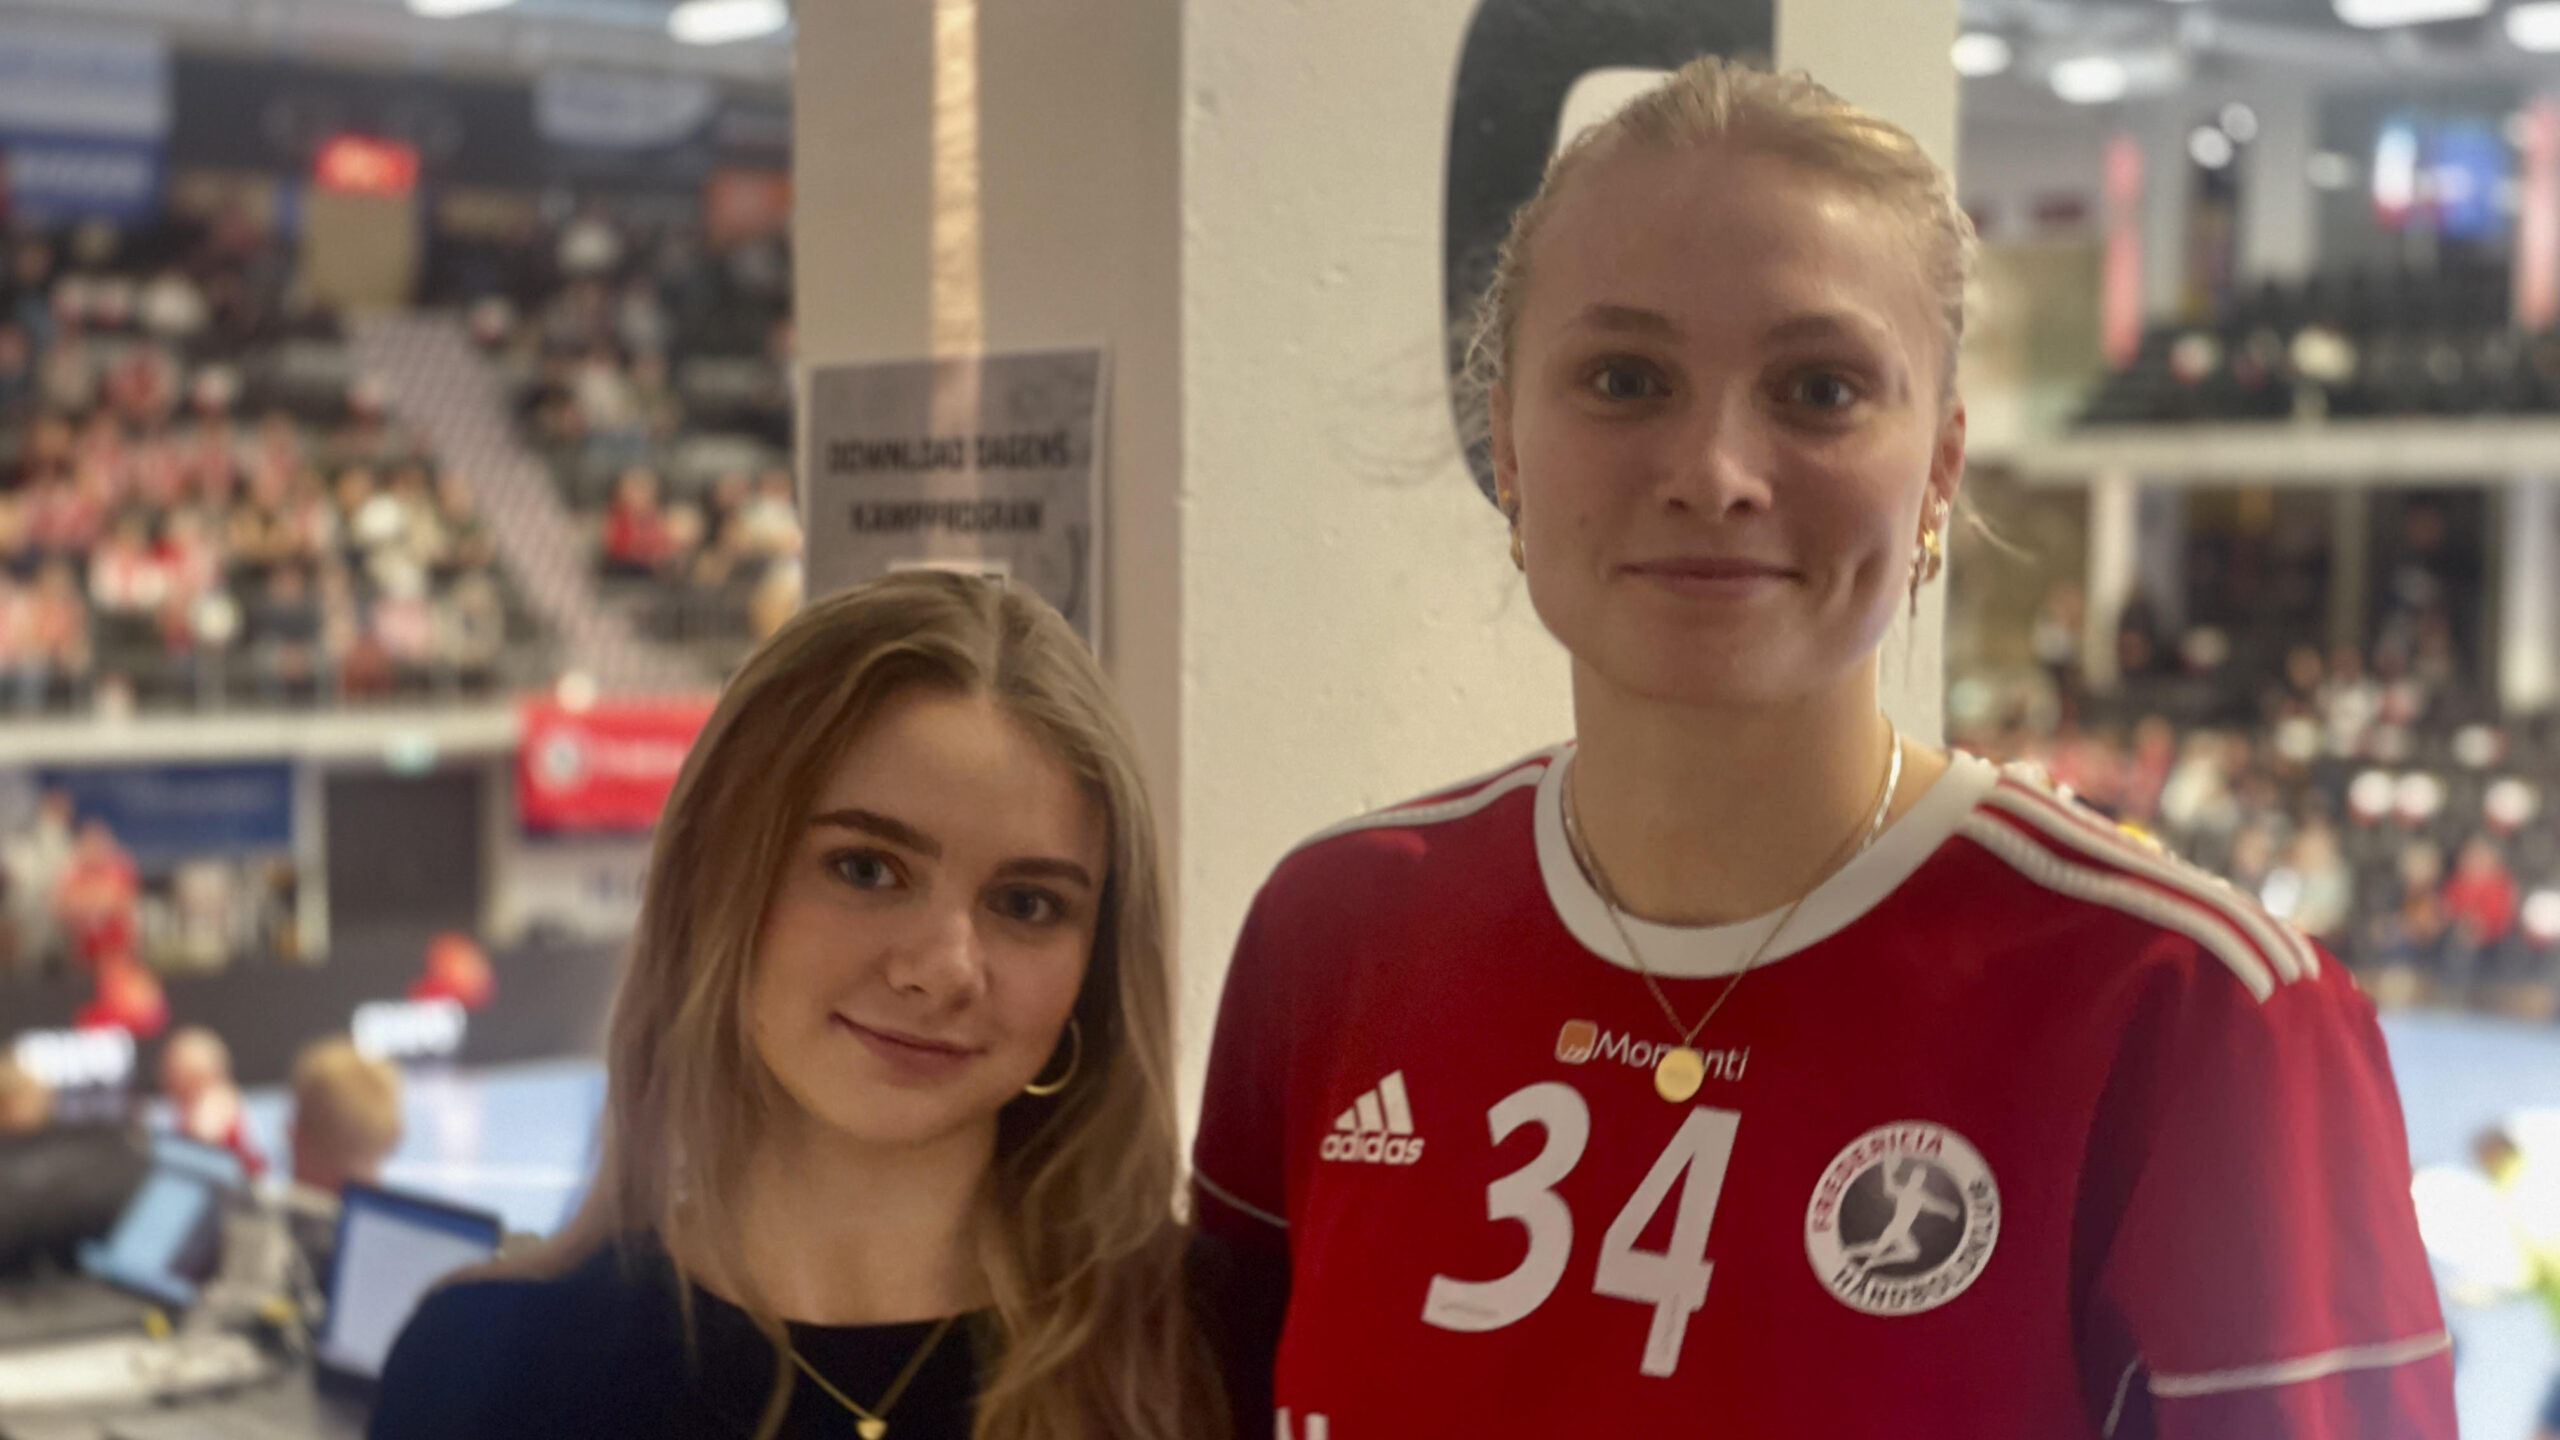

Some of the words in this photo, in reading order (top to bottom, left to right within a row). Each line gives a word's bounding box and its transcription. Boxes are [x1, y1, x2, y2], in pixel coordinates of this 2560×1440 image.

[827, 437, 964, 475] DOWNLOAD
[975, 431, 1068, 469] DAGENS
[851, 501, 1044, 533] KAMPPROGRAM
[1593, 1029, 1751, 1082] Monti
[1319, 1130, 1426, 1165] adidas
[1811, 1127, 1945, 1234] FREDERICIA
[1420, 1080, 1743, 1379] 34
